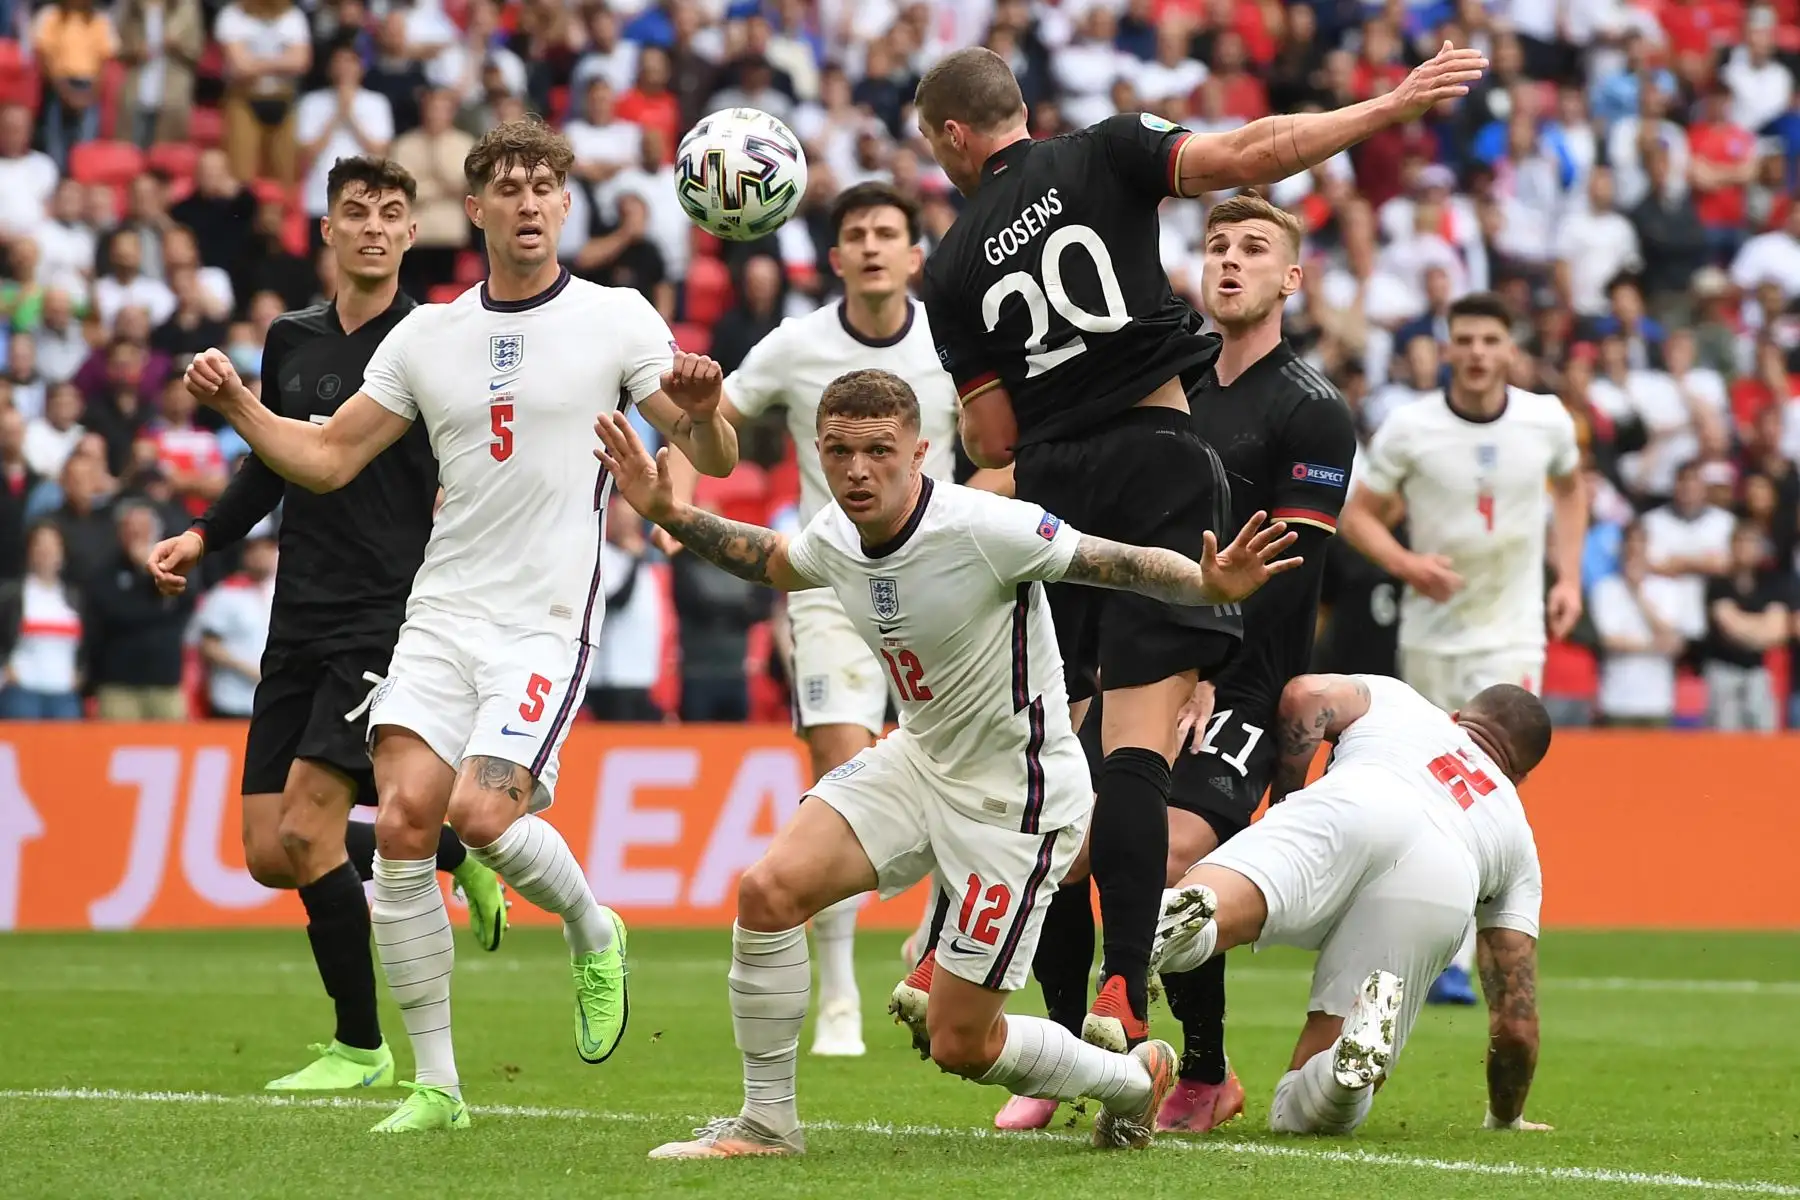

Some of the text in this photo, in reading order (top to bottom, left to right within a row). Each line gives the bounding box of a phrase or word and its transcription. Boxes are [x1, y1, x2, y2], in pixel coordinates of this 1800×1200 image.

[983, 187, 1063, 266] GOSENS
[981, 224, 1133, 379] 20
[490, 404, 514, 463] 5
[1307, 468, 1345, 483] RESPECT
[1477, 495, 1496, 533] 4
[1370, 582, 1397, 627] 6
[518, 672, 553, 723] 5
[880, 647, 934, 701] 12
[1188, 708, 1264, 778] 11
[1426, 751, 1498, 812] 2
[585, 747, 803, 908] EA
[957, 872, 1012, 946] 12
